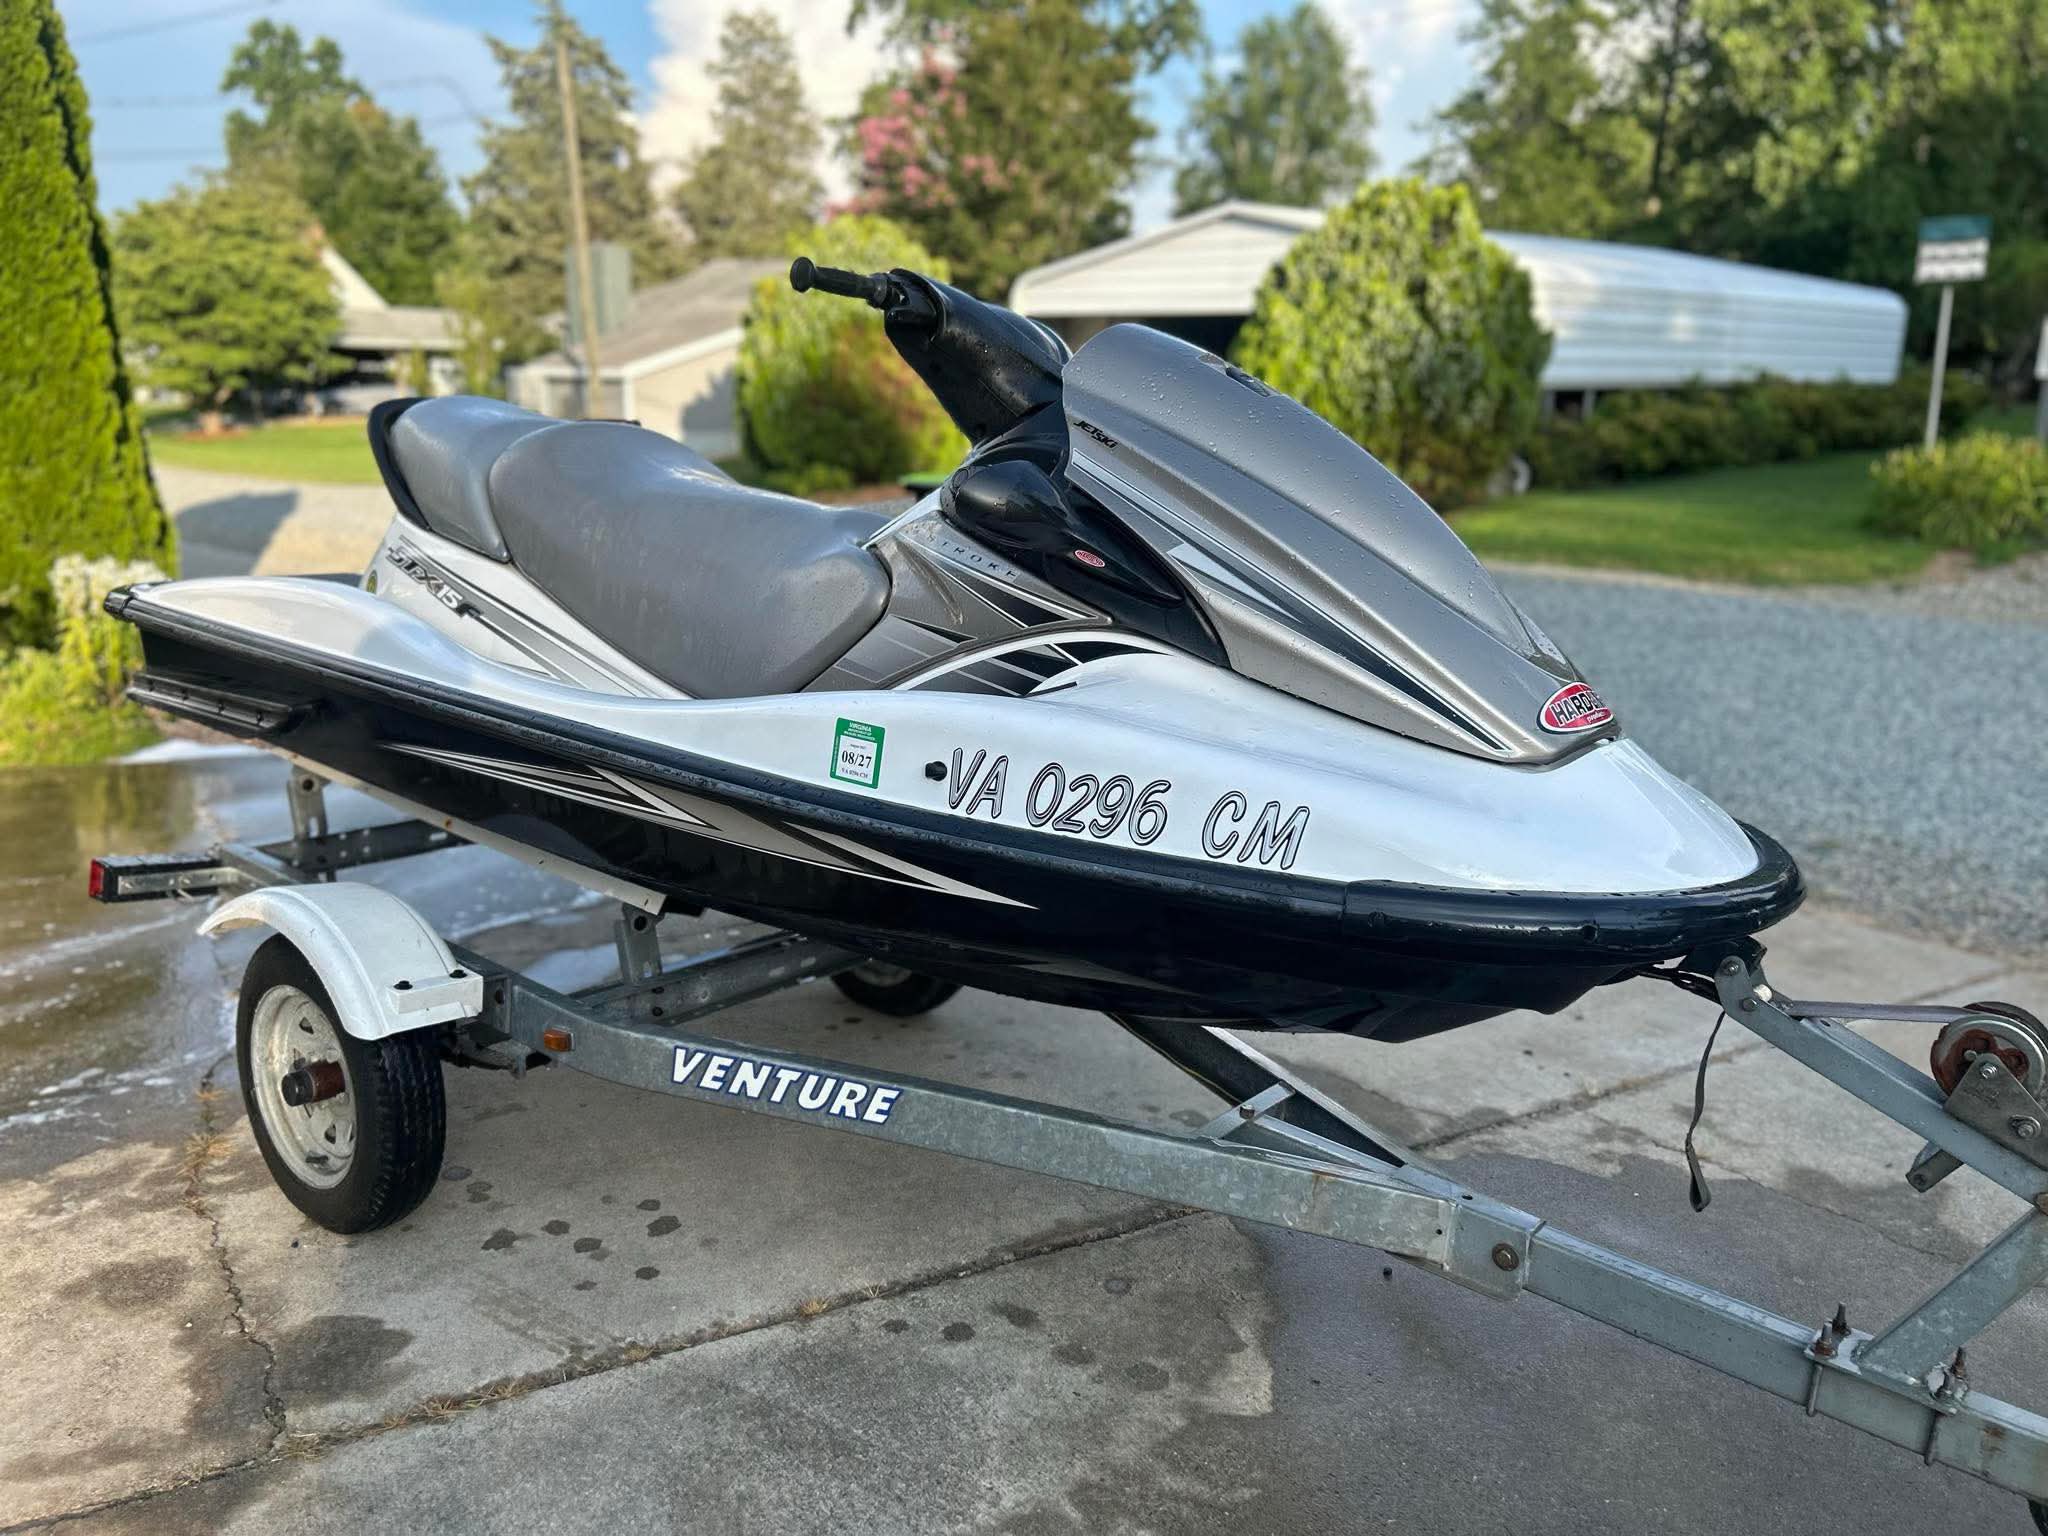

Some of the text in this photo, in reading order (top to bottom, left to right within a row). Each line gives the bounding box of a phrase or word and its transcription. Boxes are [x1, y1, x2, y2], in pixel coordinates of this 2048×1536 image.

[849, 721, 872, 733] VIRGINIA
[841, 750, 872, 769] 08/27
[948, 747, 1311, 870] VA 0296 CM
[671, 1046, 903, 1124] VENTURE
